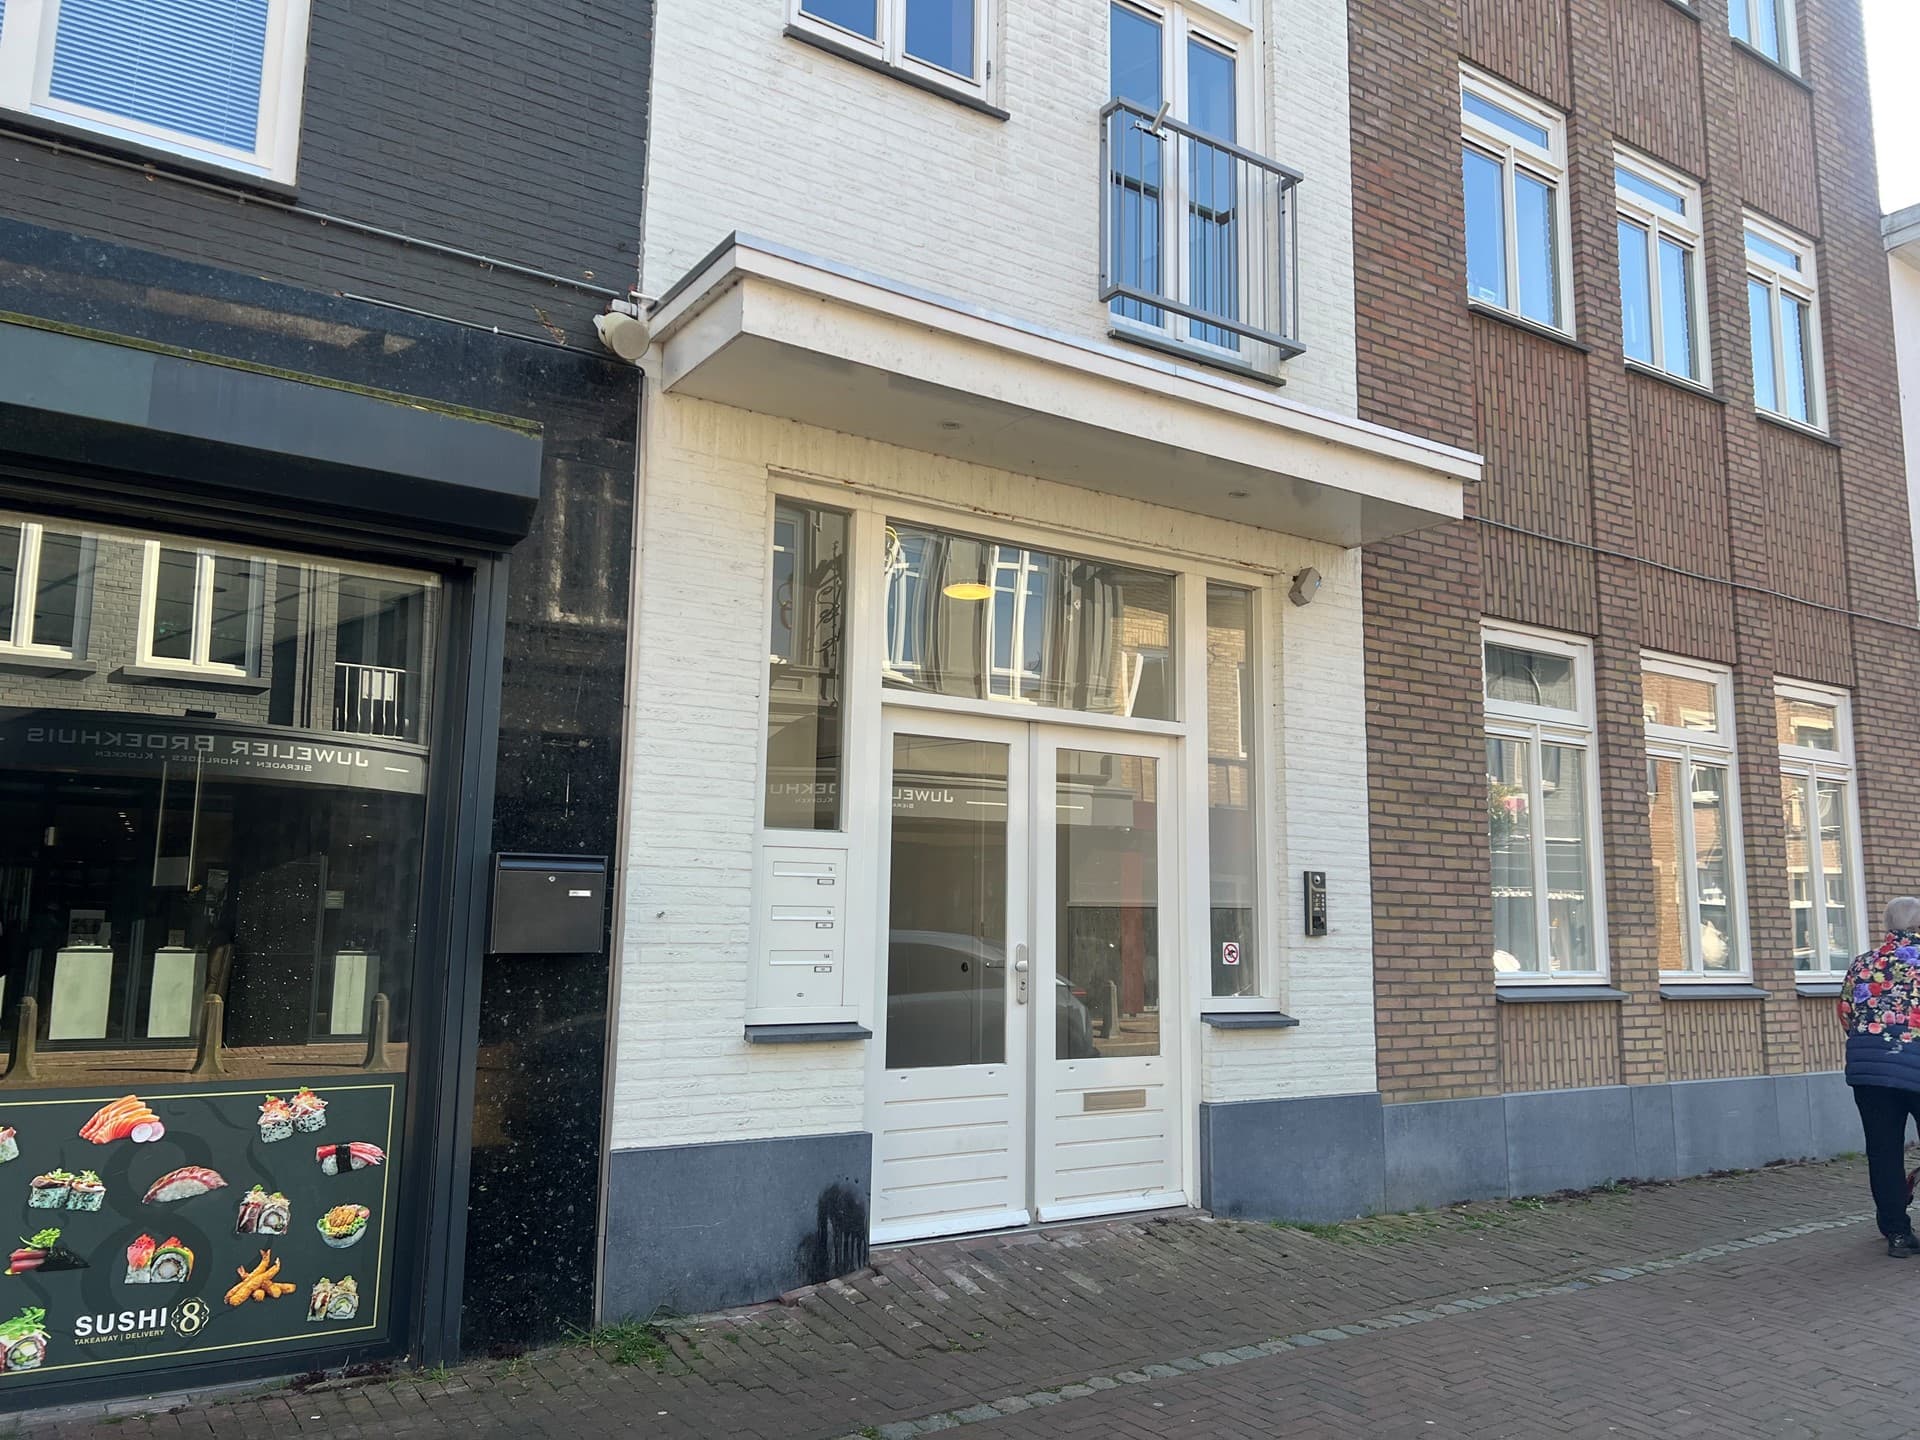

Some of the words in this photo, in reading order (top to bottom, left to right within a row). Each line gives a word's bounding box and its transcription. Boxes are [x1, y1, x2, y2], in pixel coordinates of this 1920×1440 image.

[74, 1307, 168, 1336] SUSHI
[179, 1302, 200, 1332] 8
[74, 1334, 119, 1345] TAKEAWAY
[126, 1329, 165, 1340] DELIVERY
